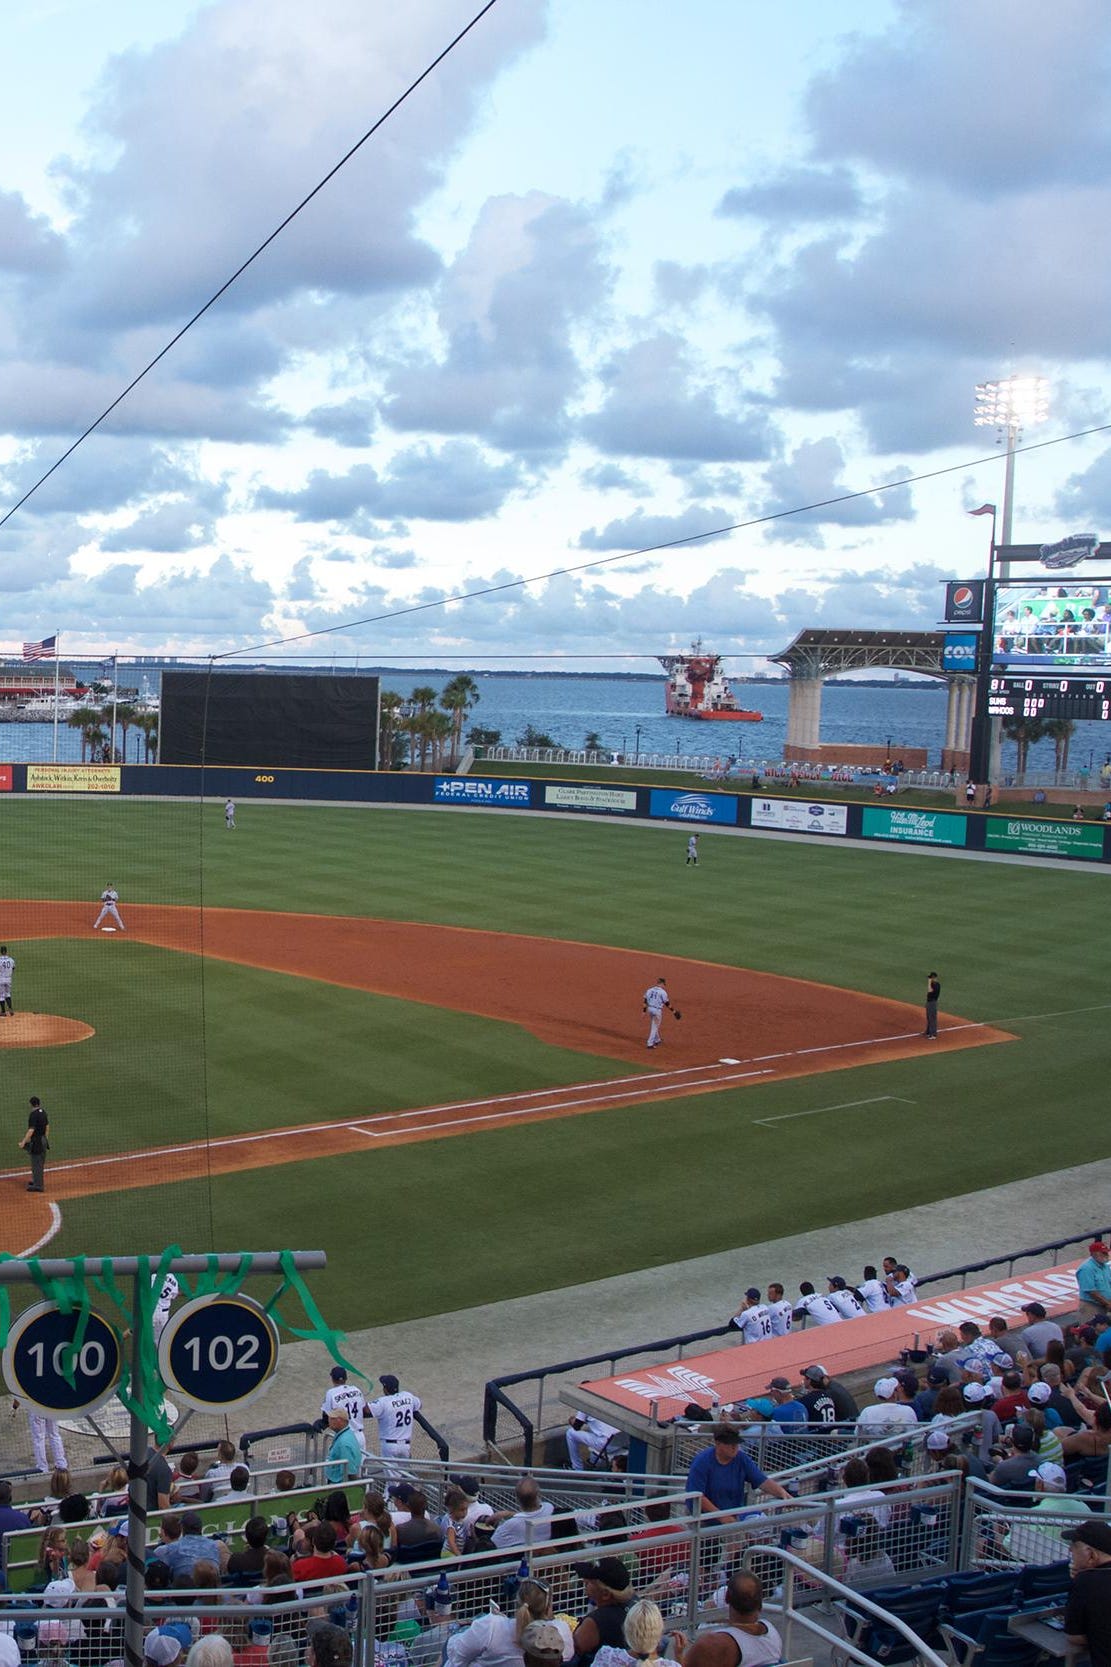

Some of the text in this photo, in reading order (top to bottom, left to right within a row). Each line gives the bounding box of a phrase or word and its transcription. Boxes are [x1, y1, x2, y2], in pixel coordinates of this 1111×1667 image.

[944, 645, 976, 658] COX
[990, 679, 1005, 690] 81
[1024, 680, 1033, 691] 0
[1059, 680, 1068, 692] 0
[1096, 681, 1104, 693] 0
[255, 775, 274, 783] 400
[450, 781, 528, 796] PEN AIR
[670, 802, 713, 816] Gulf Winds
[890, 826, 934, 837] INSURANCE
[1021, 823, 1082, 836] WOODLANDS
[760, 1318, 770, 1335] 16
[27, 1341, 106, 1377] 100
[184, 1334, 260, 1371] 102
[345, 1402, 358, 1420] 14
[395, 1408, 412, 1428] 26
[821, 1408, 836, 1422] 18
